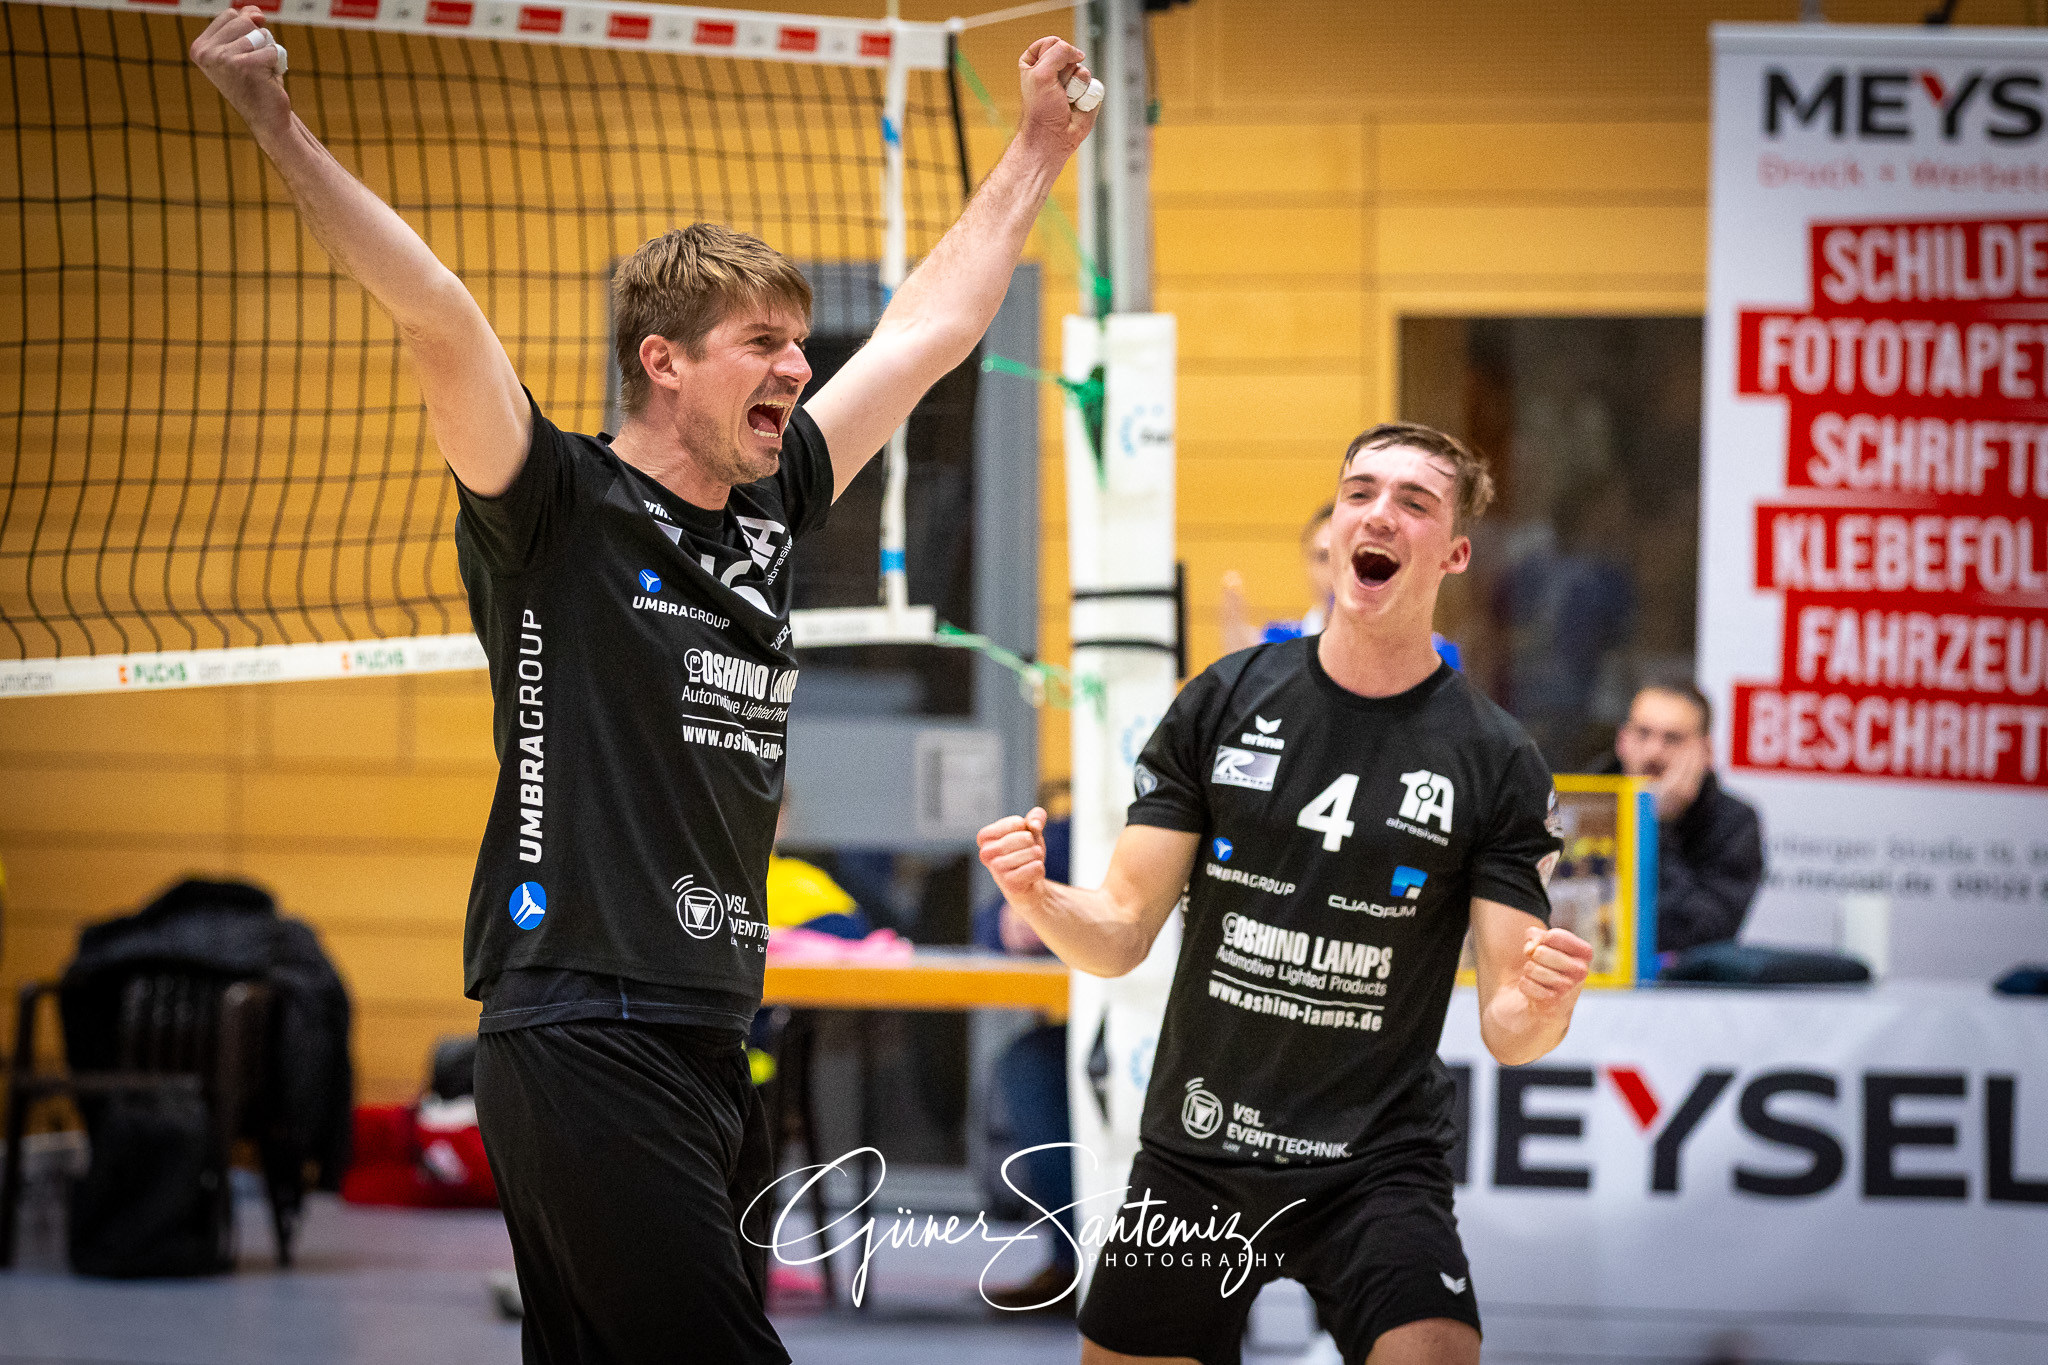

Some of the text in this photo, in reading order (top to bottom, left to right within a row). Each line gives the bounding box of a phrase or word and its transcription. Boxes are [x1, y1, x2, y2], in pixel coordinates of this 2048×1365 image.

[1764, 70, 2044, 138] MEYS
[632, 595, 730, 630] UMBRAGROUP
[702, 650, 770, 700] OSHINO
[1798, 605, 2048, 696] FAHRZEU
[518, 609, 545, 864] UMBRAGROUP
[1297, 773, 1360, 852] 4
[1386, 817, 1449, 847] abrasives
[725, 893, 750, 915] VSL
[1206, 862, 1296, 896] UMBRAGROUP
[1216, 944, 1388, 997] Automotive Lighted Products
[1233, 915, 1393, 980] OSHINO LAMPS
[1208, 979, 1384, 1033] www.oshino-lamps.de
[1233, 1101, 1265, 1128] VSL
